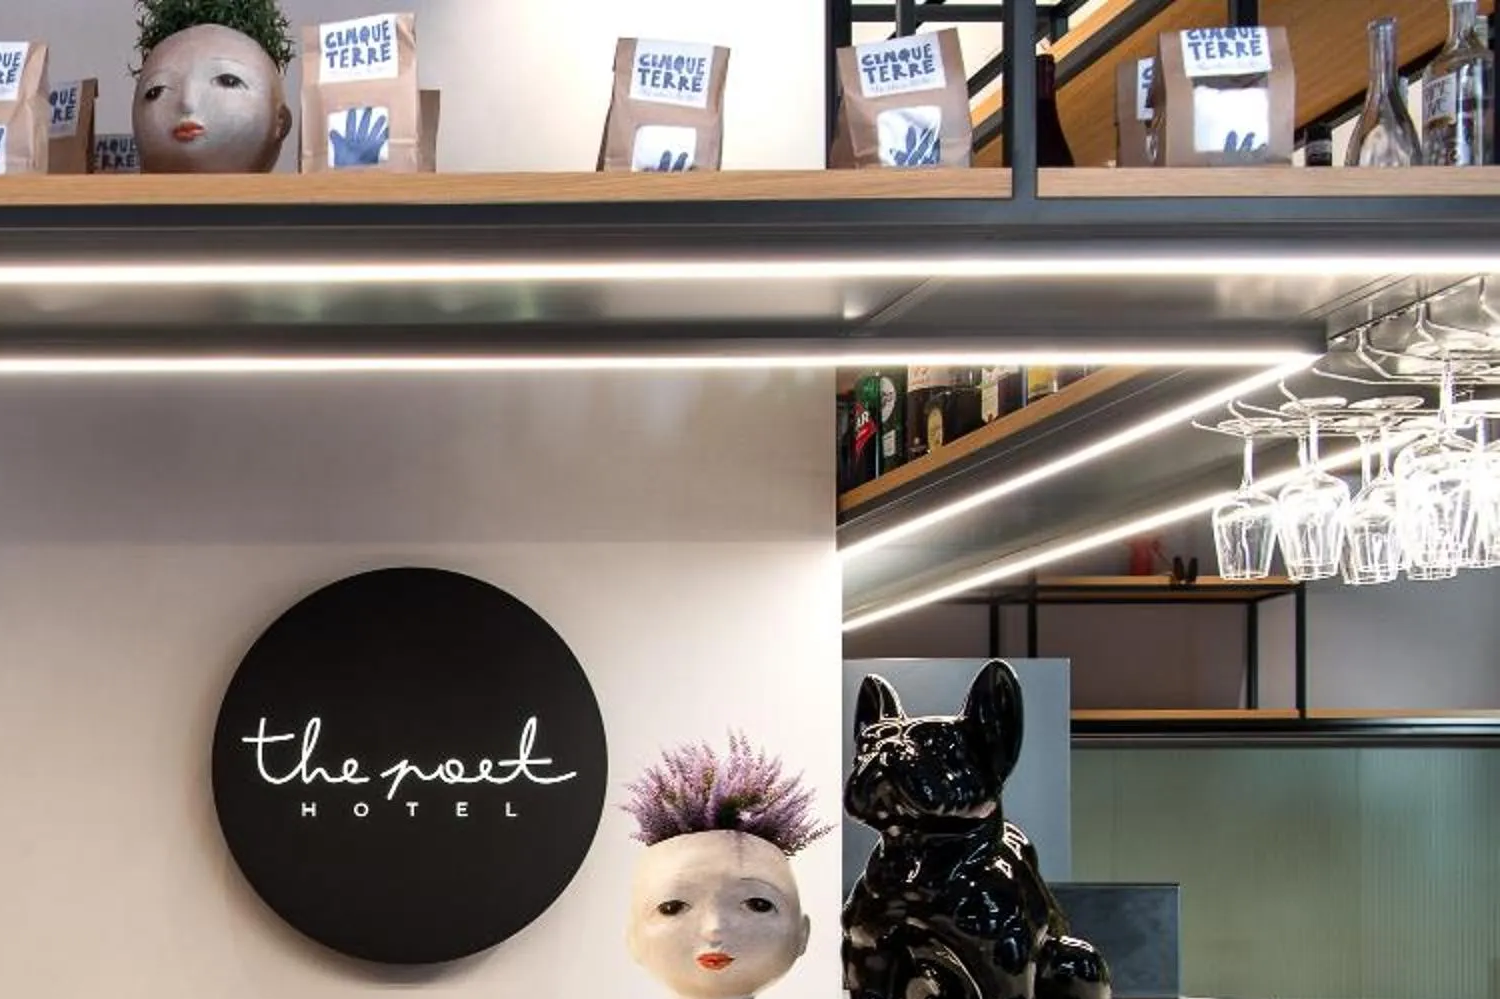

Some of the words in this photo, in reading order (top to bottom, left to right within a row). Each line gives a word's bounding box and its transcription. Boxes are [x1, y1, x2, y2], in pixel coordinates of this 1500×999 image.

[325, 20, 391, 48] CINQUE
[325, 42, 391, 68] TERRE
[862, 43, 933, 66] CINQUE
[1188, 40, 1263, 61] TERRE
[639, 53, 707, 75] CINQUE
[863, 60, 936, 84] TERRE
[638, 67, 703, 92] TERRE
[49, 88, 77, 106] QUE
[96, 139, 138, 154] NQUE
[241, 717, 370, 784] the
[380, 716, 577, 800] poet
[300, 801, 518, 818] HOTEL
